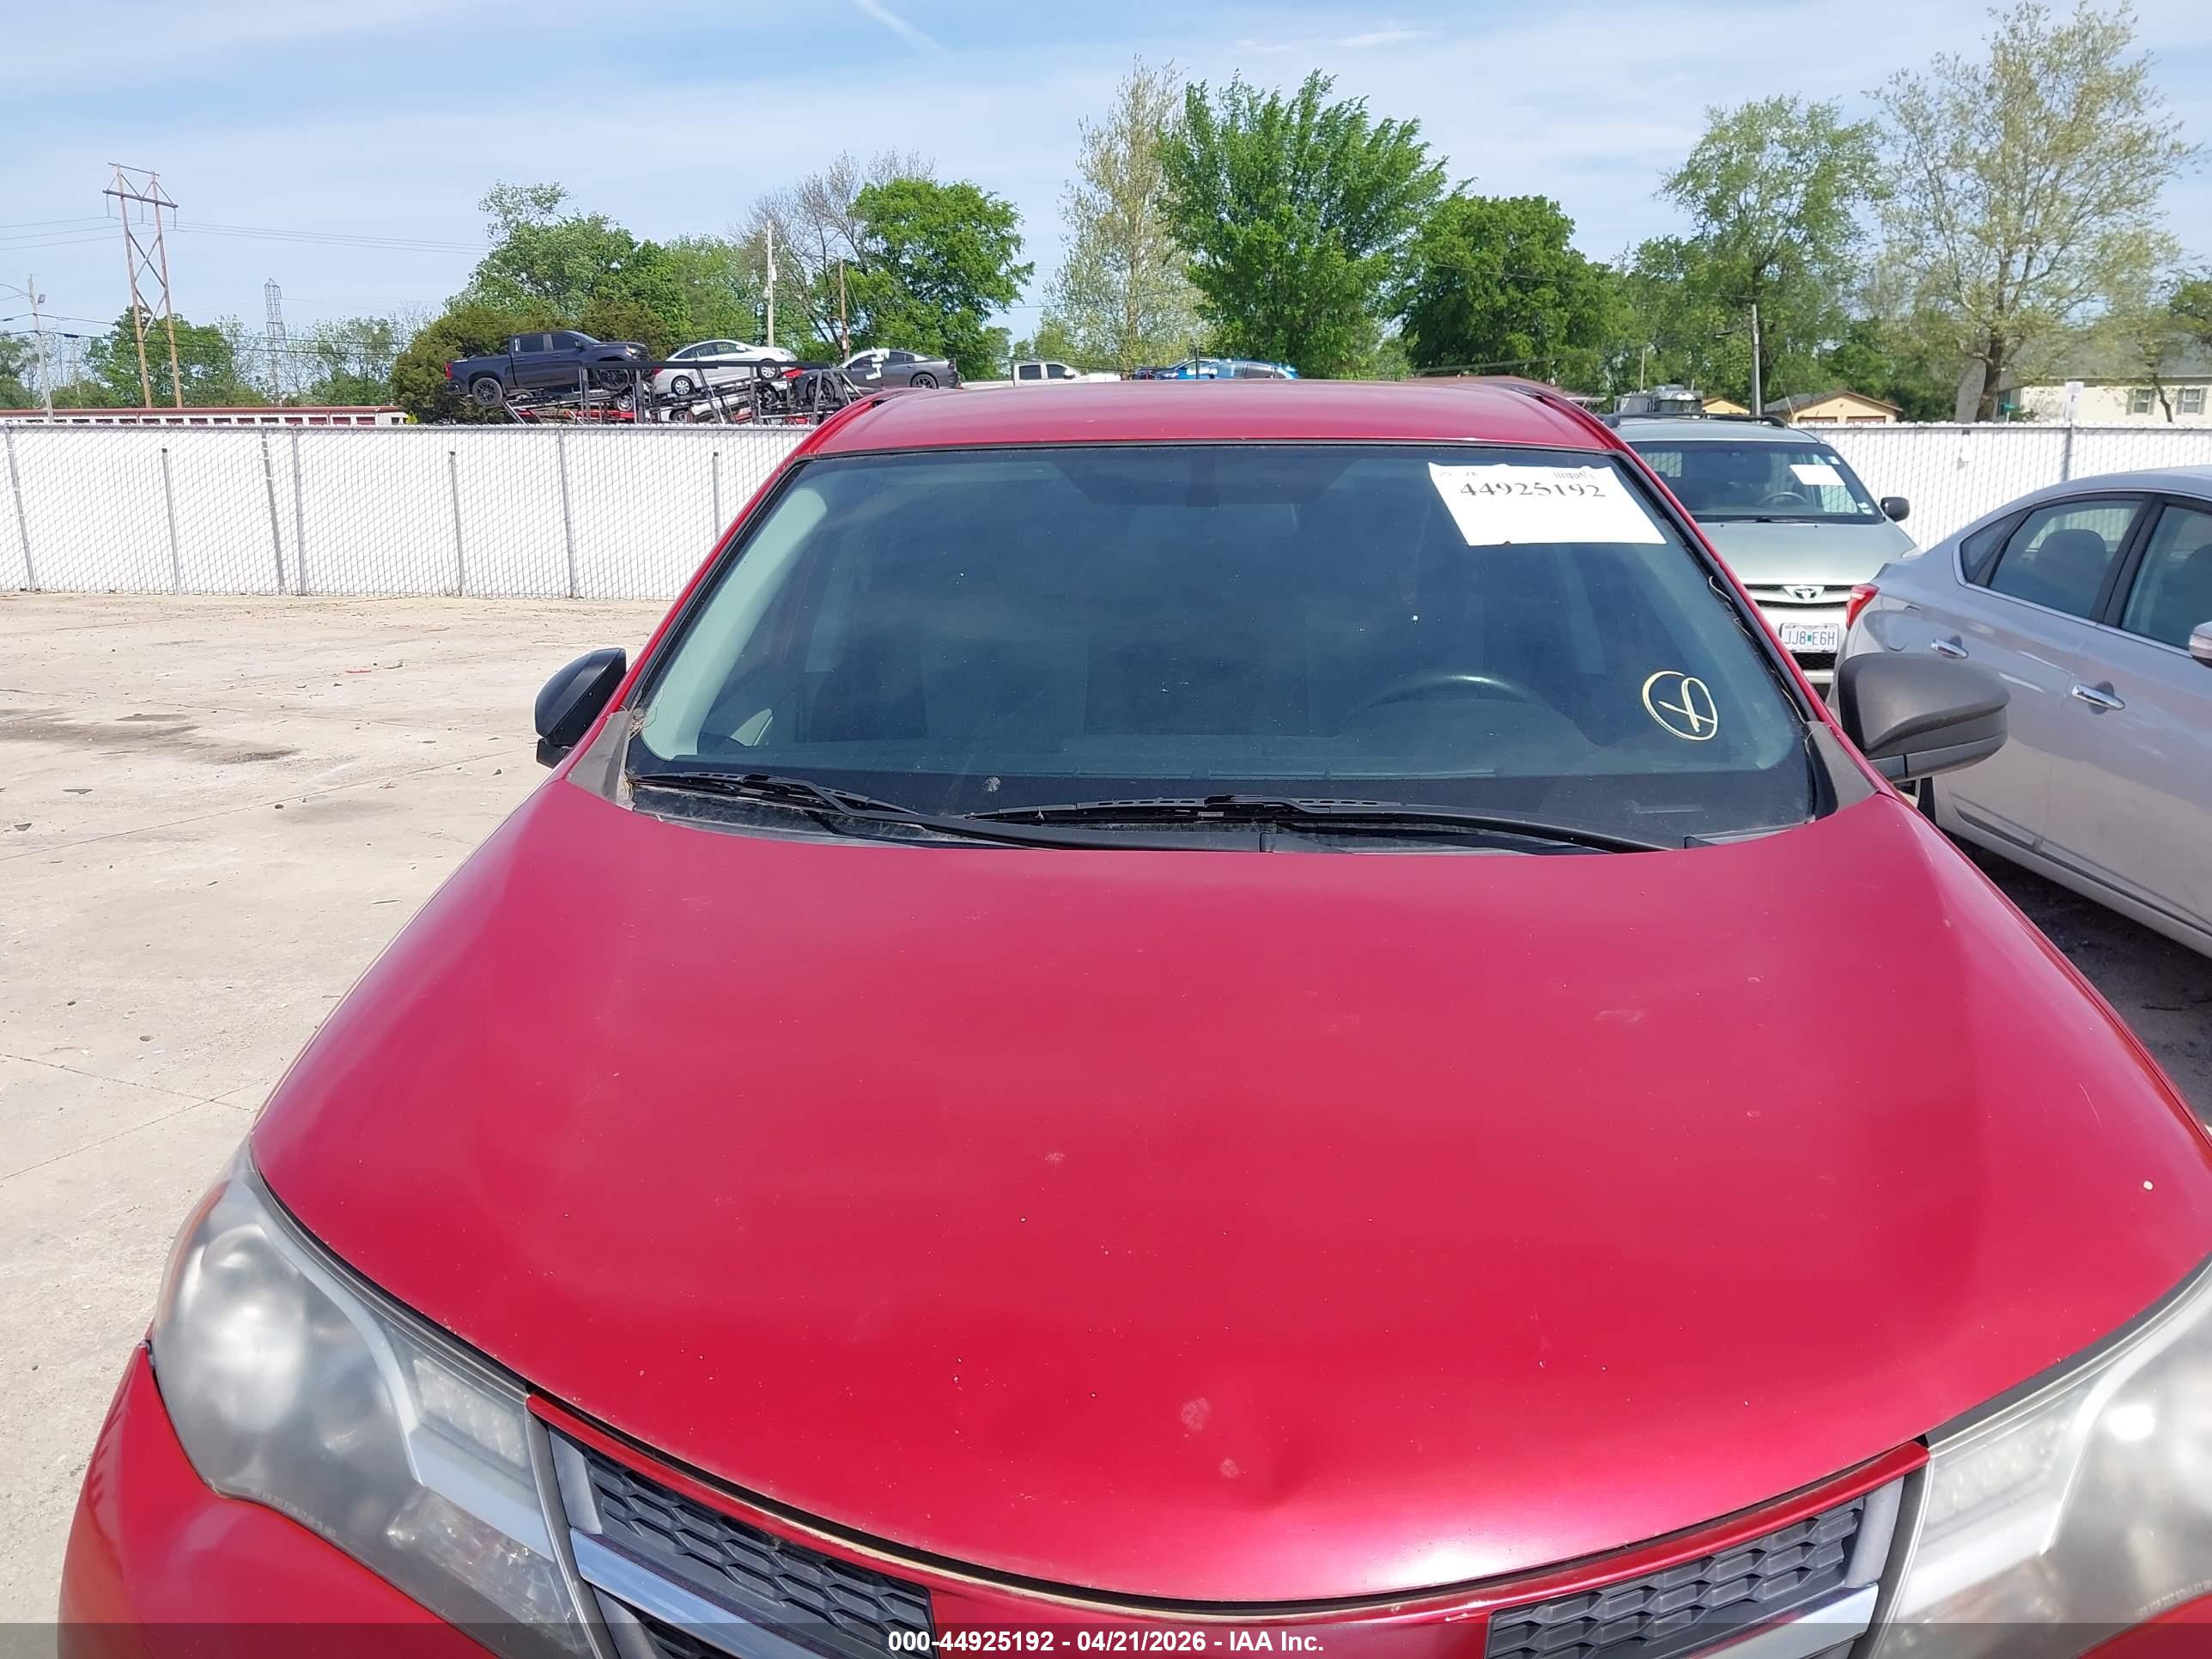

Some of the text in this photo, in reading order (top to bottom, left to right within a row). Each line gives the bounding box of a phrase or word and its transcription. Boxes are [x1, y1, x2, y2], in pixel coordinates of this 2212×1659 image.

[1461, 482, 1606, 497] 44925192
[1784, 631, 1835, 646] JJ8 E6H
